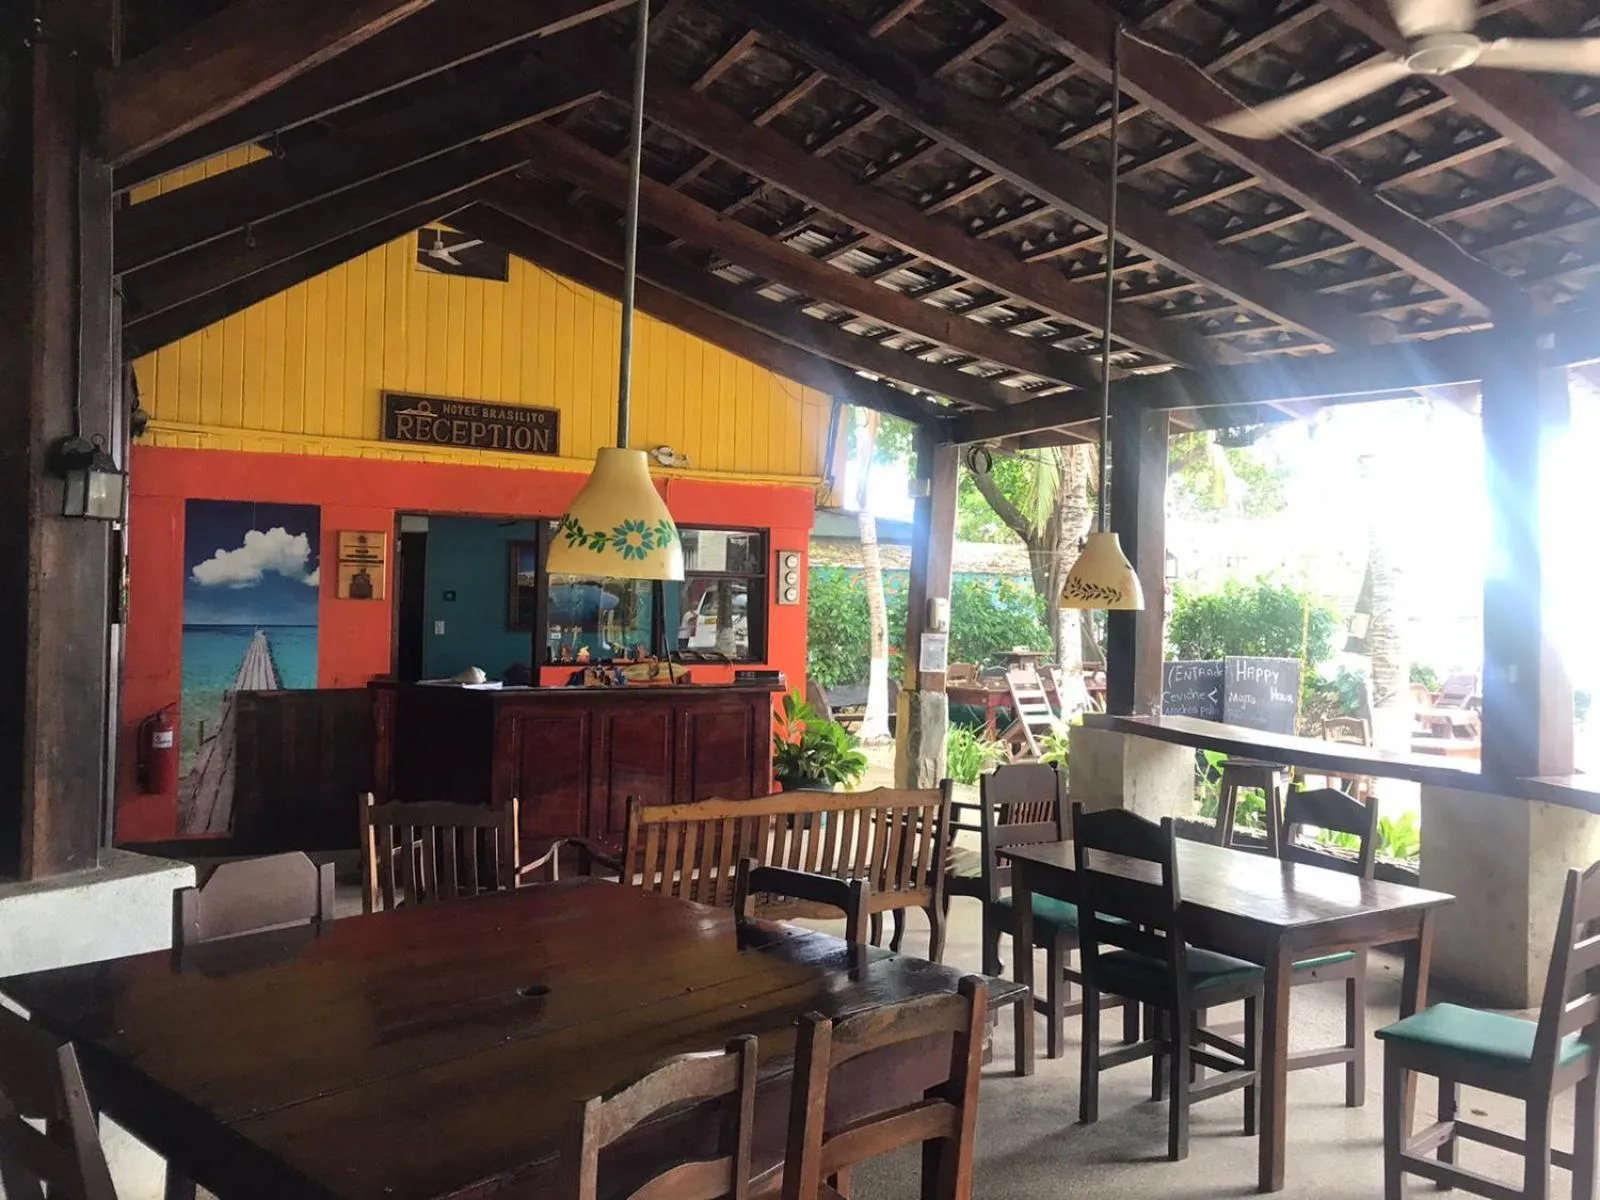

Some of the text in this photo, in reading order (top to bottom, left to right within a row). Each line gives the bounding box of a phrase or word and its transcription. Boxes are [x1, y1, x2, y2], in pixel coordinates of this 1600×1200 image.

[443, 403, 545, 423] HOTEL BRASILITO
[396, 415, 550, 452] RECEPTION
